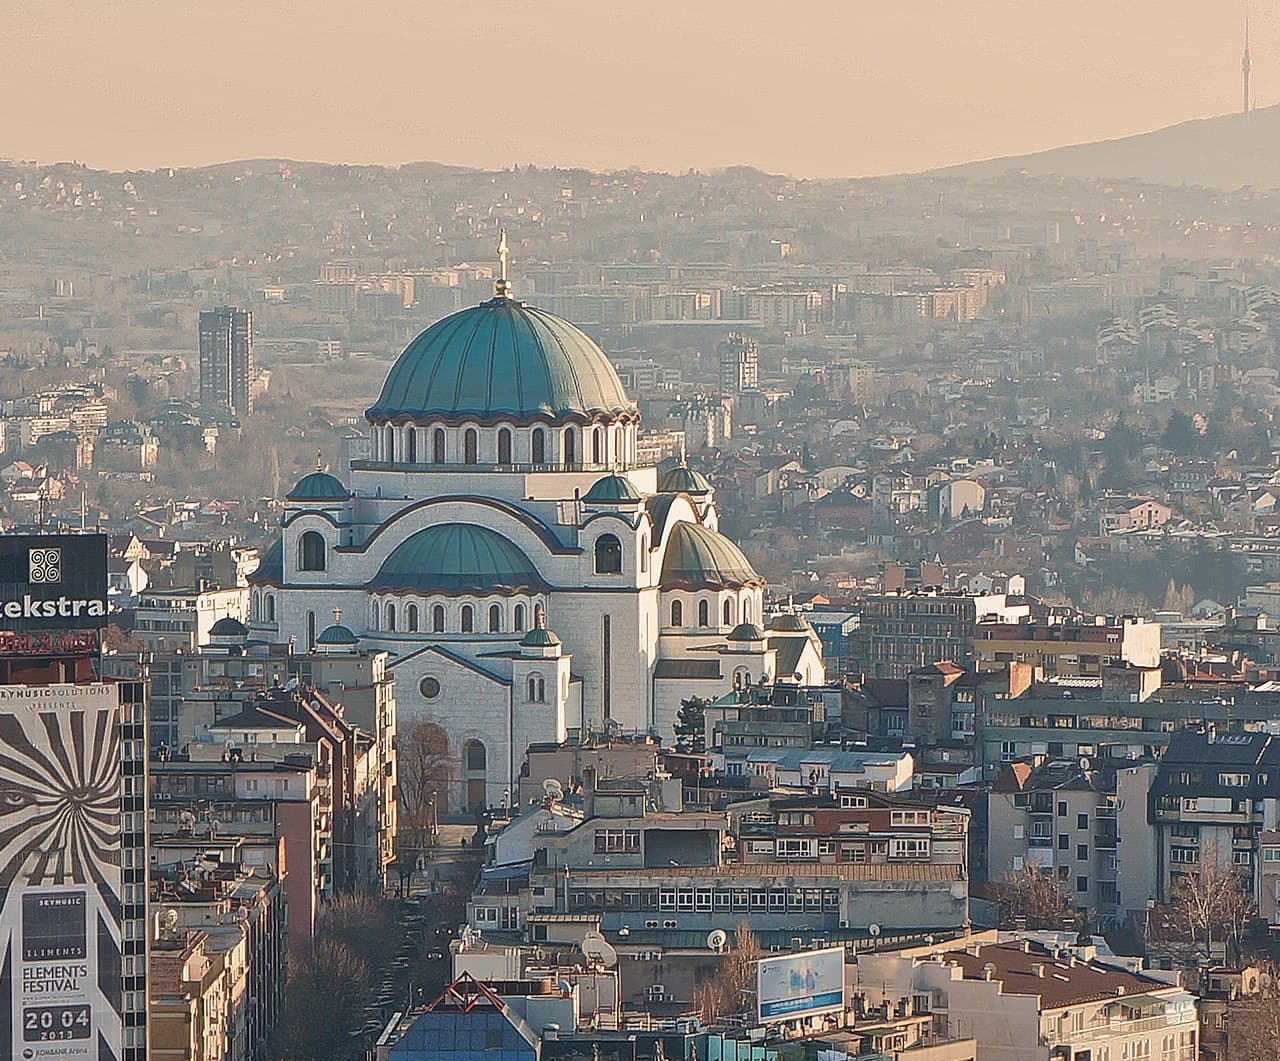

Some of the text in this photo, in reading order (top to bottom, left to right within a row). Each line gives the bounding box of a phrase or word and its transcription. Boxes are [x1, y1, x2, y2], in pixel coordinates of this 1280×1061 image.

[23, 965, 87, 980] ELEMENTS
[23, 979, 80, 993] FESTIVAL
[25, 1008, 89, 1029] 20 04
[40, 1030, 73, 1041] 2013
